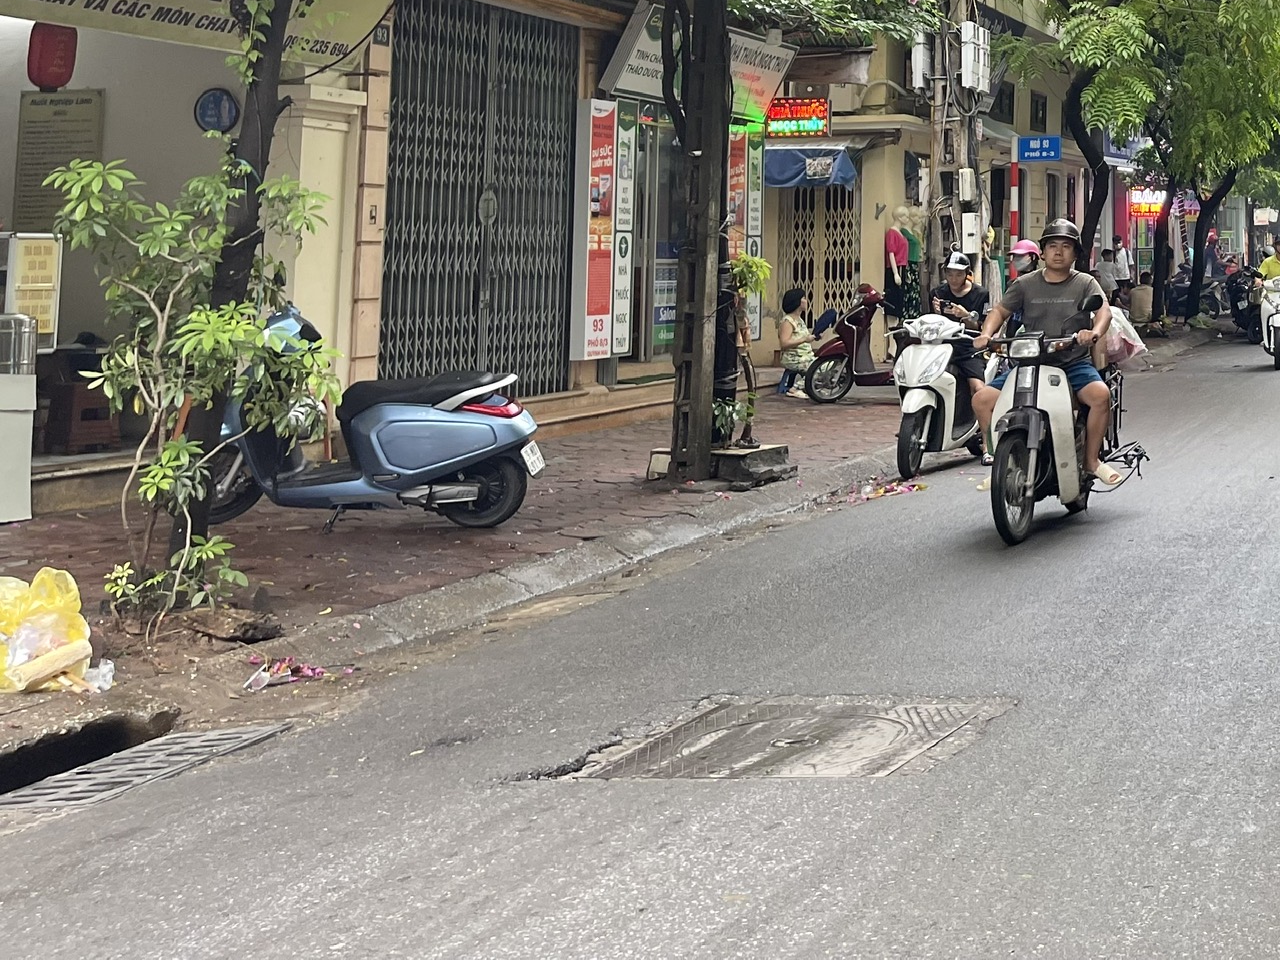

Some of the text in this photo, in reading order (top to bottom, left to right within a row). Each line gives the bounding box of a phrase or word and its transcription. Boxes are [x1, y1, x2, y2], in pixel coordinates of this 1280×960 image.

[150, 6, 192, 27] MÓN
[194, 15, 239, 34] CHAY
[376, 27, 388, 42] 93
[309, 39, 329, 54] 235
[329, 42, 351, 58] 694
[634, 48, 663, 64] TINH CH
[770, 101, 825, 119] NHÀ THUỐC
[769, 119, 798, 134] NGỌC
[600, 144, 613, 157] SỨC
[1043, 140, 1049, 148] 93
[618, 263, 628, 275] NHÀ
[615, 286, 629, 300] THUỐC
[615, 312, 628, 326] NGỌC
[659, 307, 676, 321] Salon
[592, 318, 604, 332] 93
[587, 336, 608, 348] PHỐ 8/3
[615, 334, 627, 348] THỦY
